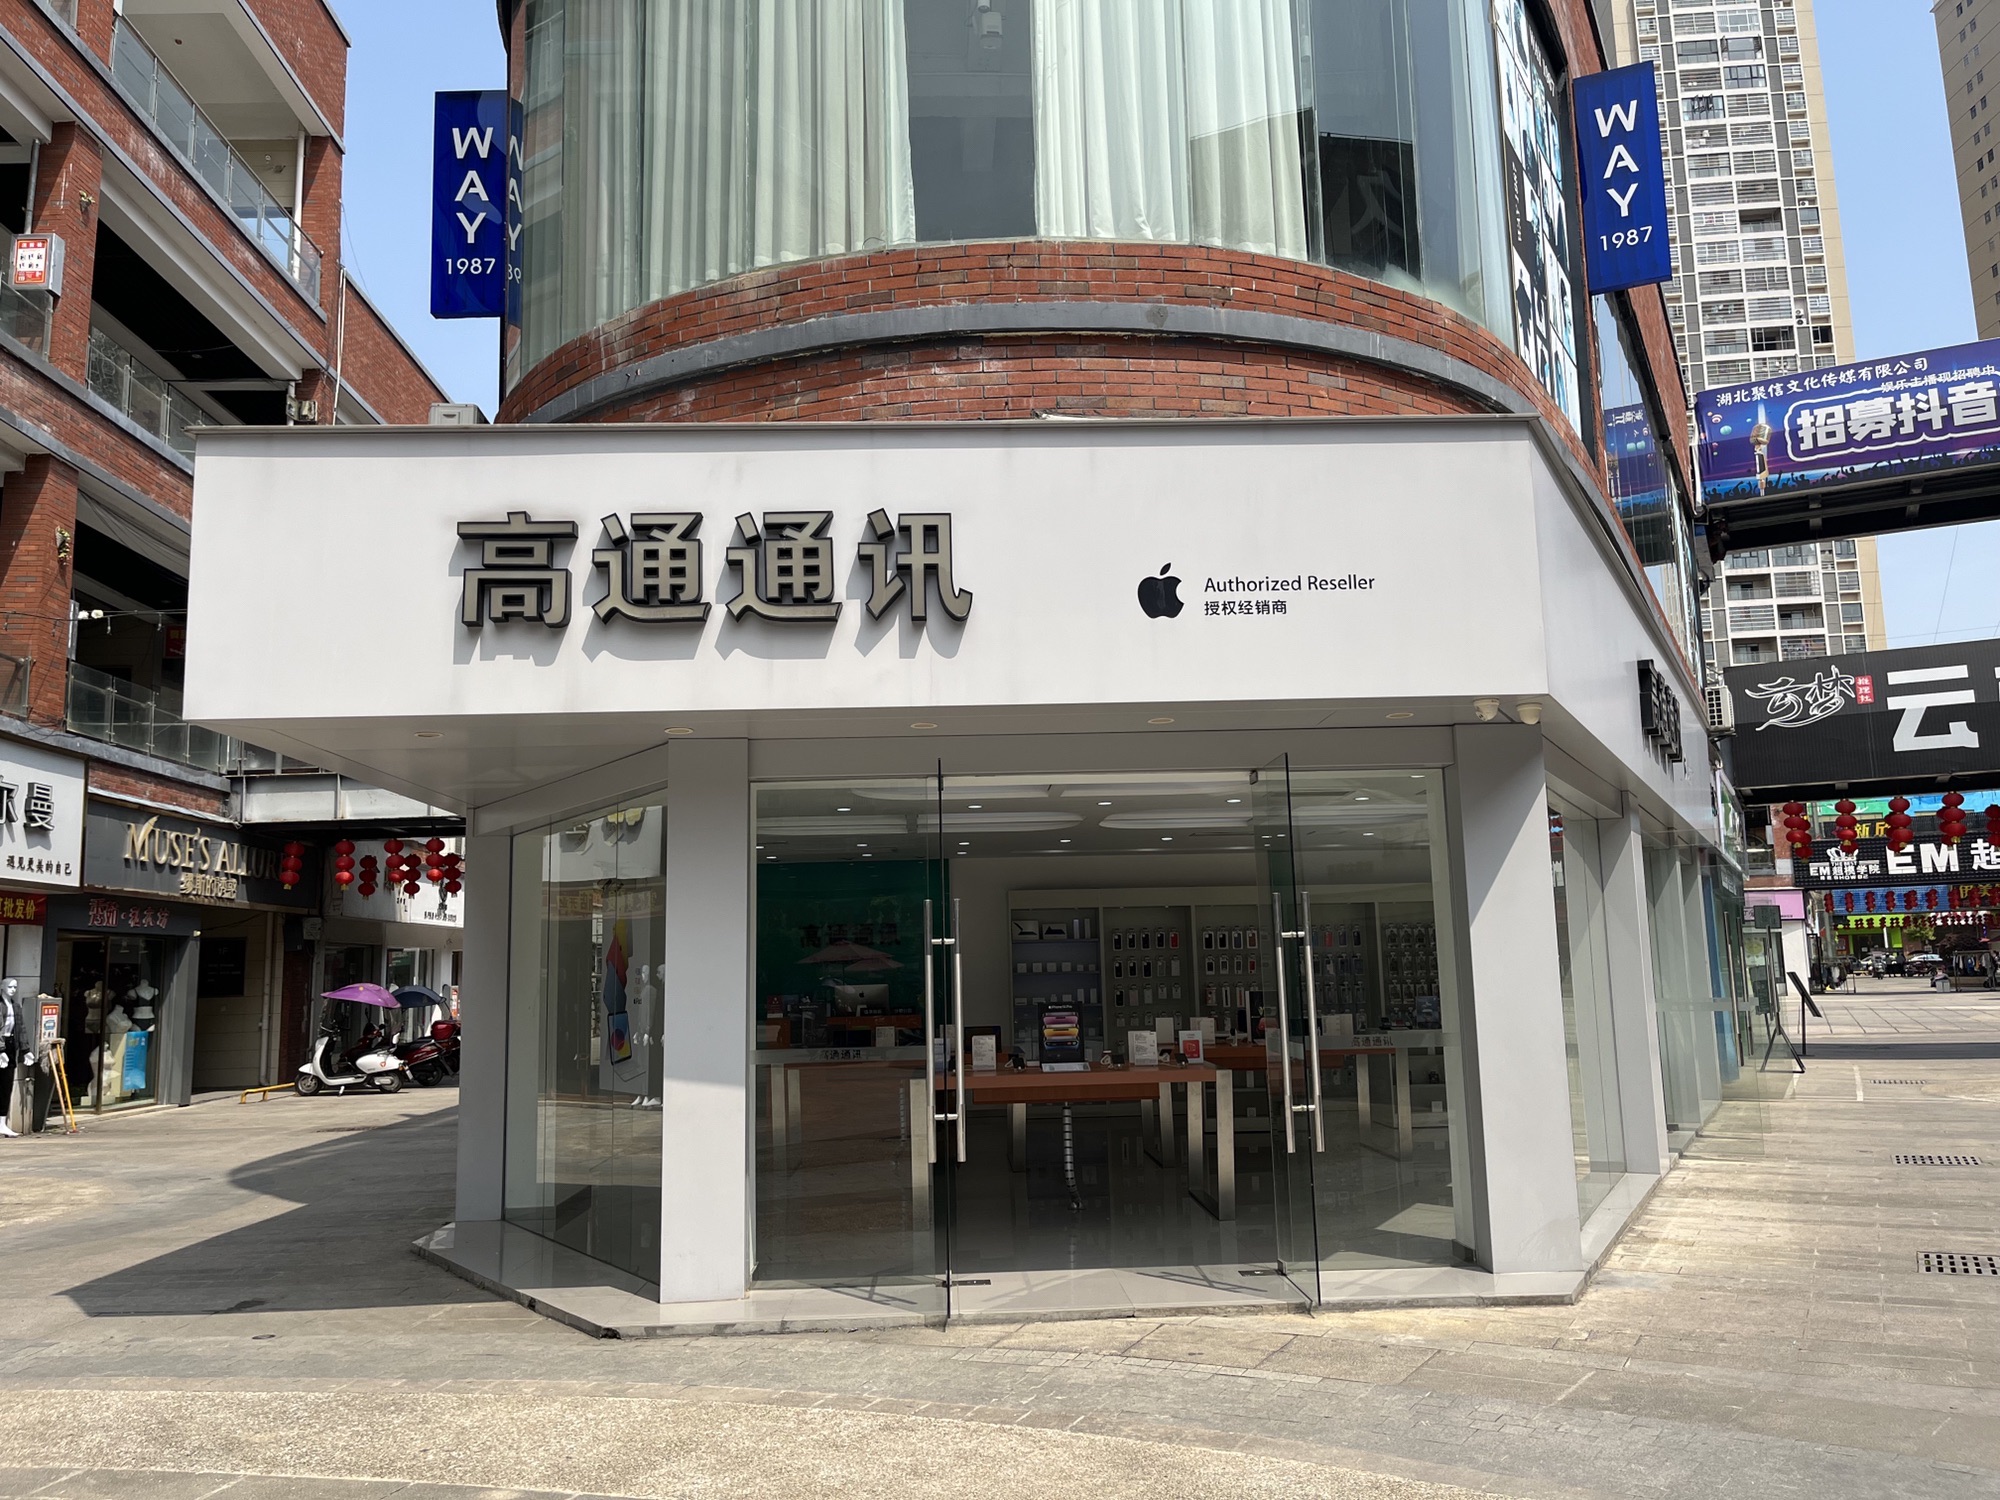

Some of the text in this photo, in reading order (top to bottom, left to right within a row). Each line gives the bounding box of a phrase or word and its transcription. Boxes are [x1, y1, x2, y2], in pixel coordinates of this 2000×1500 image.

[1594, 99, 1640, 217] WAY
[452, 126, 494, 244] WAY
[1599, 225, 1653, 251] 1987
[445, 257, 496, 275] 1987
[1715, 356, 1929, 408] 湖北聚信文化传媒有限公司
[1796, 380, 1997, 451] 招募抖音
[457, 507, 973, 627] 高通通讯
[1204, 573, 1375, 593] Authorized Reseller
[1204, 599, 1288, 616] 授权经销商
[1886, 664, 2000, 752] 云
[121, 815, 211, 872] MUSE'S
[1885, 842, 1960, 875] EM
[6, 855, 73, 876] 遇见更美的自己
[0, 896, 37, 921] 批发价
